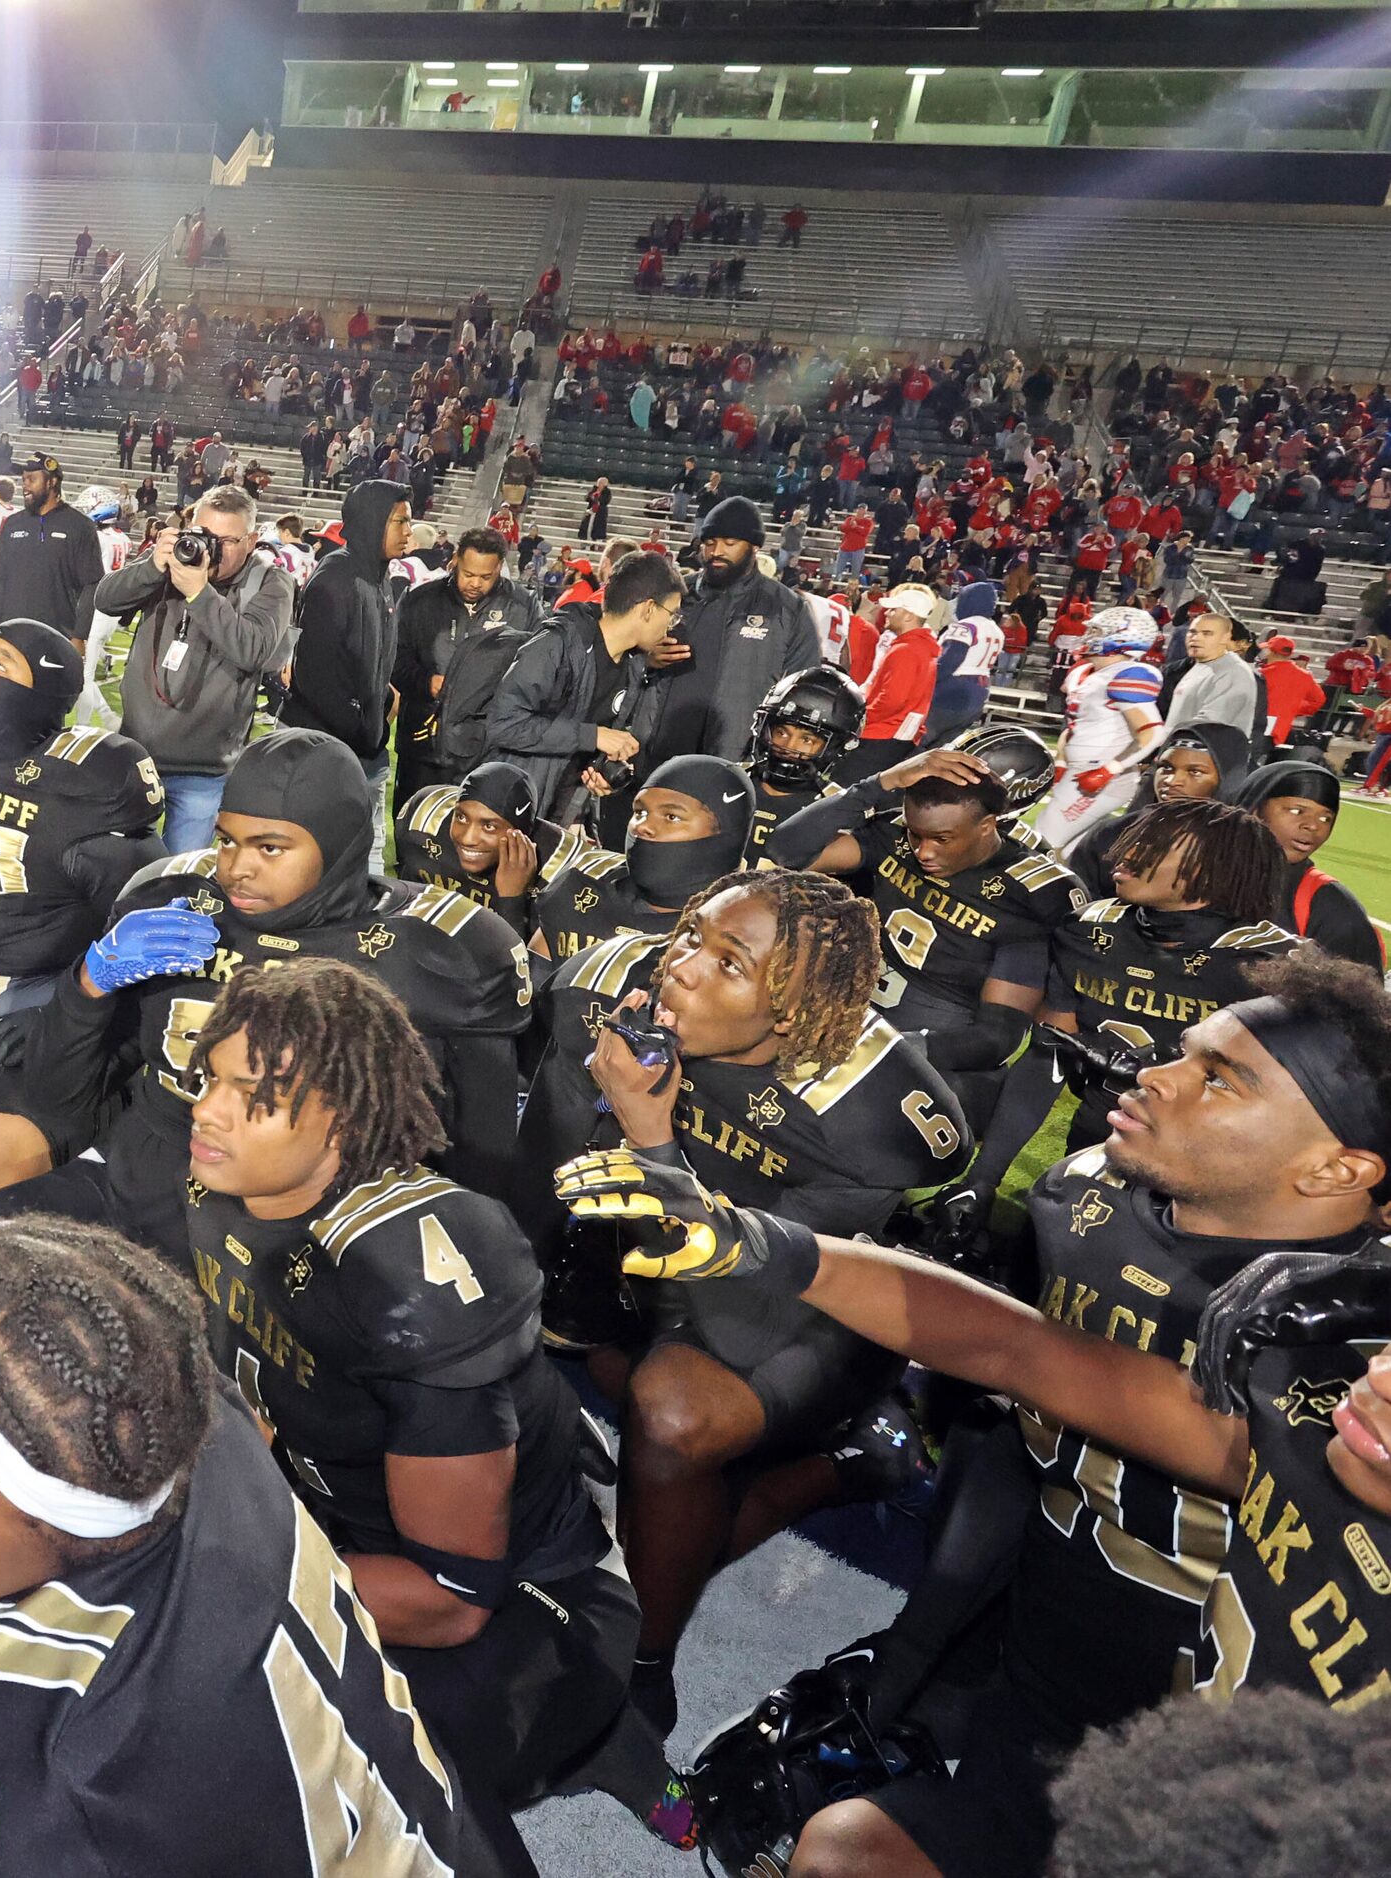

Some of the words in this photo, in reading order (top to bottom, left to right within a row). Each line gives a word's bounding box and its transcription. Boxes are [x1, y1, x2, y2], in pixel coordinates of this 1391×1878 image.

[135, 756, 165, 805] 5
[203, 899, 216, 911] 21
[878, 856, 924, 899] OAK
[922, 888, 996, 938] CLIFF
[371, 931, 389, 945] 22
[1074, 969, 1119, 1006] OAK
[1125, 985, 1219, 1024] CLIFF
[901, 1089, 960, 1160] 6
[419, 1213, 484, 1304] 4
[228, 1275, 316, 1391] CLIFF
[1044, 1275, 1100, 1331] AK
[1238, 1448, 1314, 1586] AK
